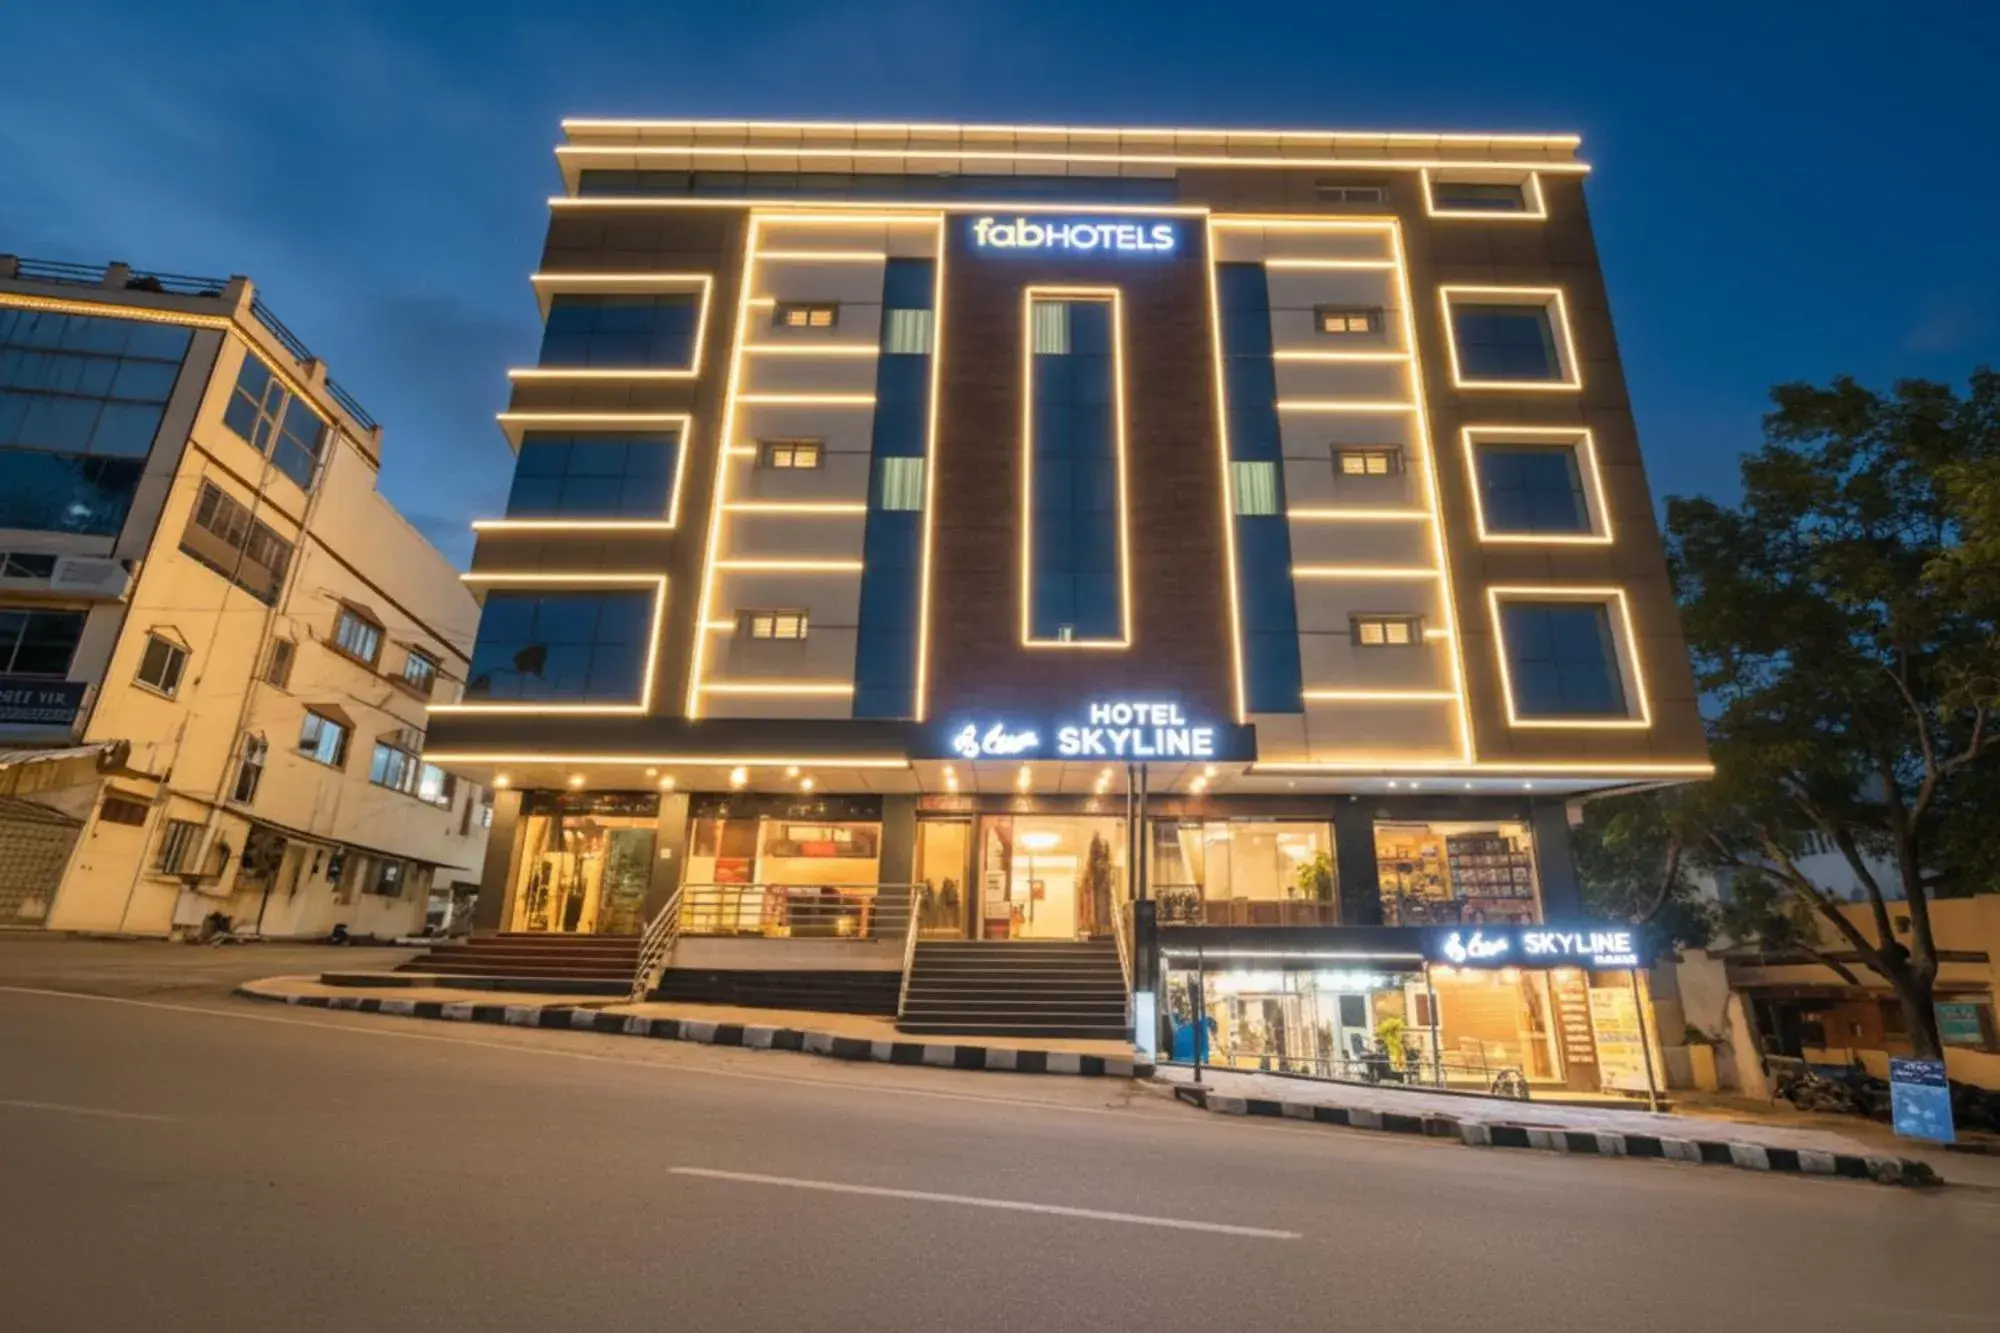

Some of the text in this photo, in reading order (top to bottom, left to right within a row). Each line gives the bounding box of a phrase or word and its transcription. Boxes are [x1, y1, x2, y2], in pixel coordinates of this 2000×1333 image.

[973, 217, 1174, 251] fabHOTELS
[1090, 703, 1185, 725] HOTEL
[1058, 727, 1214, 755] SKYLINE
[1523, 932, 1631, 955] SKYLINE
